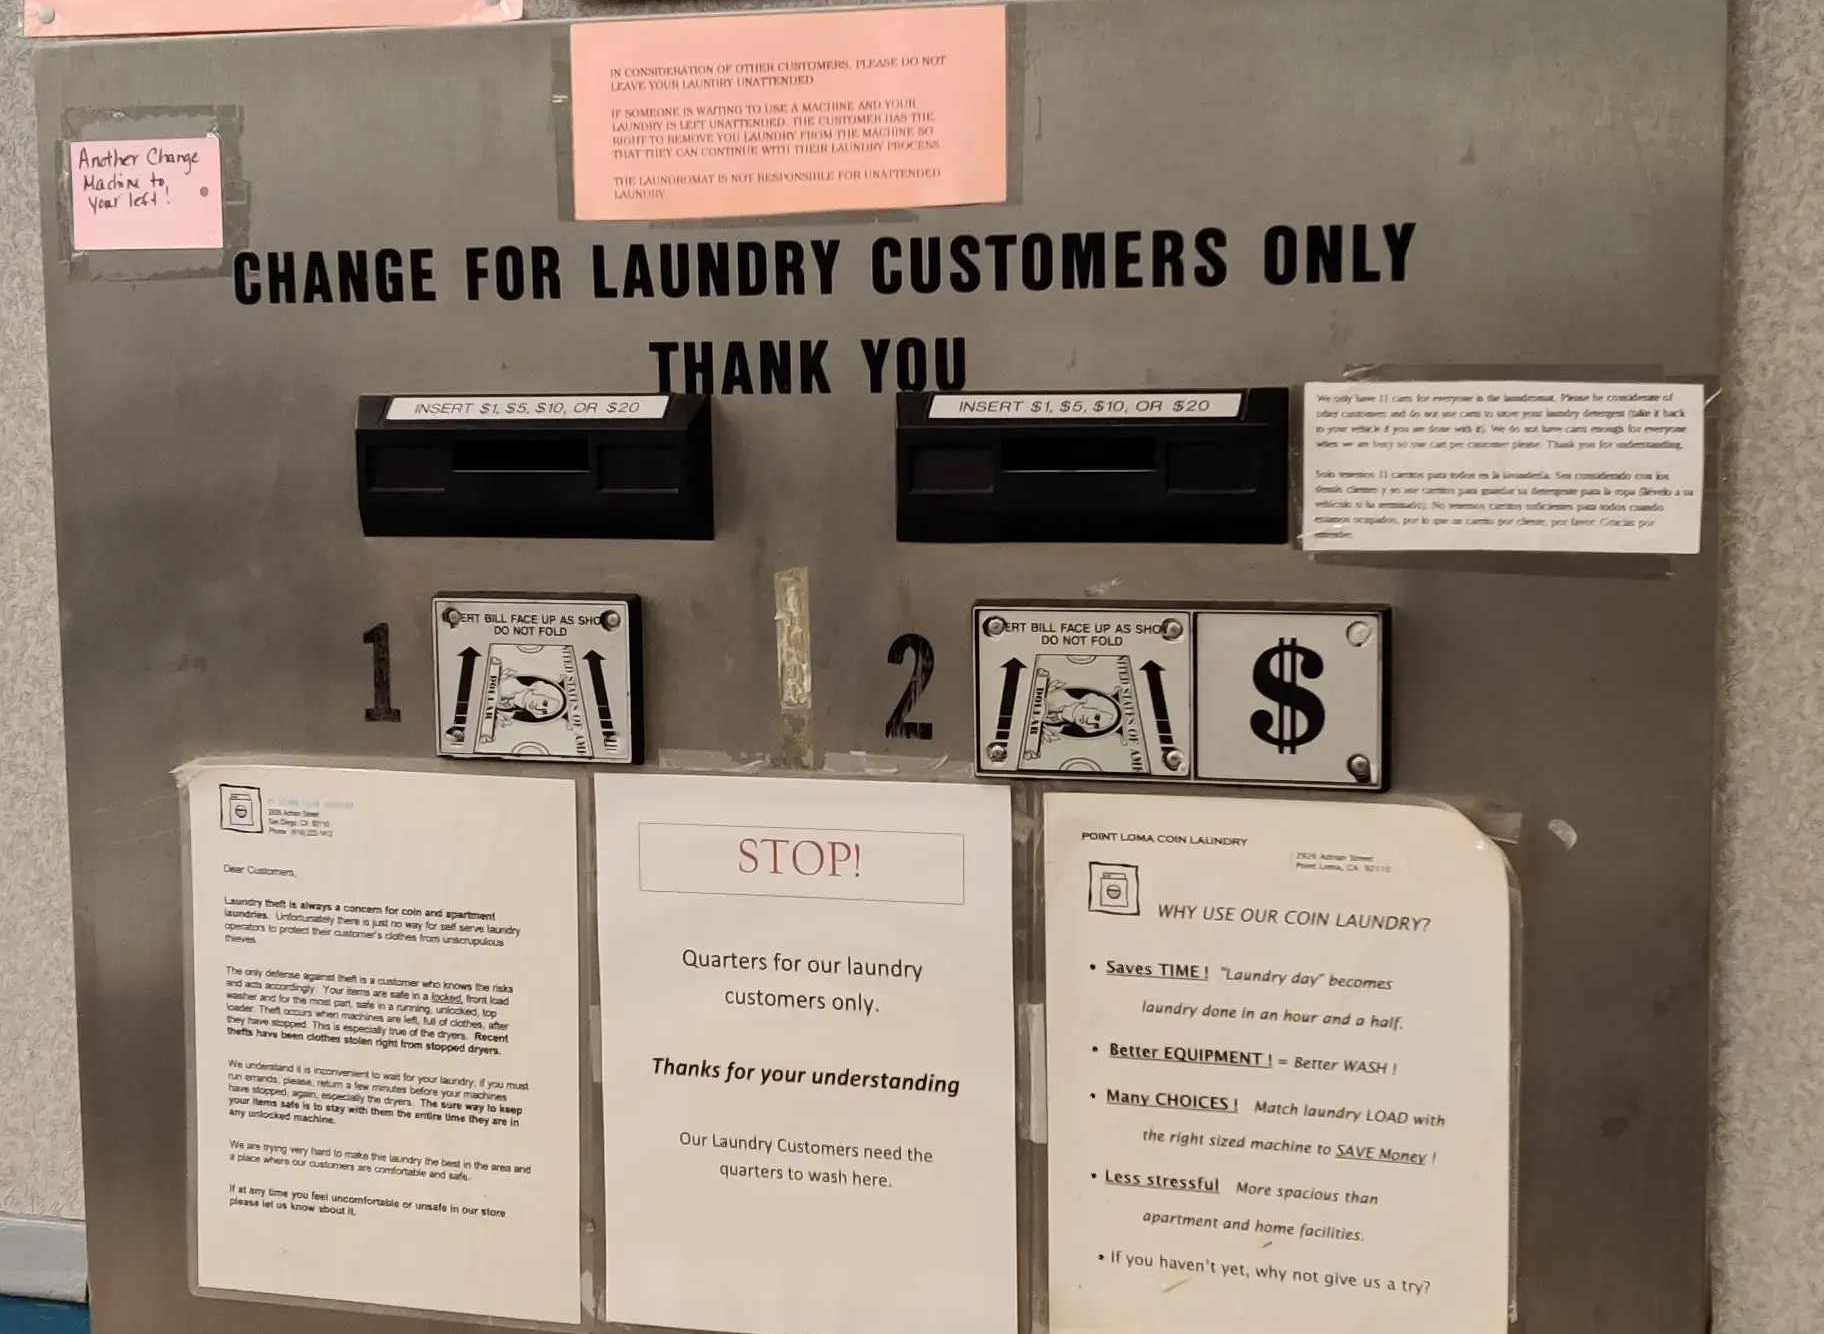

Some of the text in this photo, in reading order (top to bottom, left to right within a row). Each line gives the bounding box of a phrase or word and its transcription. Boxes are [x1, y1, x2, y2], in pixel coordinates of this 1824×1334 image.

[611, 69, 621, 79] IN
[624, 65, 713, 77] CONSIDERATION
[717, 63, 732, 74] OF
[736, 63, 774, 74] OTHER
[856, 57, 897, 69] PLEASE
[902, 57, 918, 67] DO
[923, 55, 946, 66] NOT
[79, 147, 200, 175] Another Change
[234, 223, 1416, 305] CHANGE FOR LAUNDRY CUSTOMERS ONLY
[649, 336, 966, 395] THANK YOU
[415, 402, 639, 415] INSERT $1, $5, $10, OR $20
[959, 400, 1209, 413] INSERT $1, $5, $10, OR $20
[485, 614, 506, 624] BILL
[511, 614, 538, 624] FACE
[542, 615, 556, 625] UP
[560, 615, 574, 625] AS
[494, 626, 567, 636] DO NOT FOLD
[1031, 623, 1056, 633] BILL
[1060, 623, 1090, 633] FACE
[1095, 623, 1111, 634] UP
[1115, 623, 1131, 634] AS
[1042, 635, 1123, 646] DO NOT FOLD
[363, 621, 402, 723] 1
[885, 633, 935, 741] 2
[1082, 832, 1247, 845] POINT LOMA COIN LAUNDRY
[739, 839, 859, 877] STOP!
[1159, 905, 1431, 932] WHY USE OUR COIN LAUNDRY?
[683, 950, 922, 982] Quarters for our laundry
[725, 990, 879, 1016] customers only.
[653, 1058, 959, 1097] Thanks for your understanding
[680, 1132, 932, 1162] Our Laundry Customers need the
[720, 1165, 891, 1187] quarters to wash here.
[1105, 1170, 1378, 1204] Less stressful More spacious than
[1143, 1213, 1363, 1241] apartment and home facilities.
[1112, 1251, 1430, 1295] If you haven't yet, why not give us a try?
